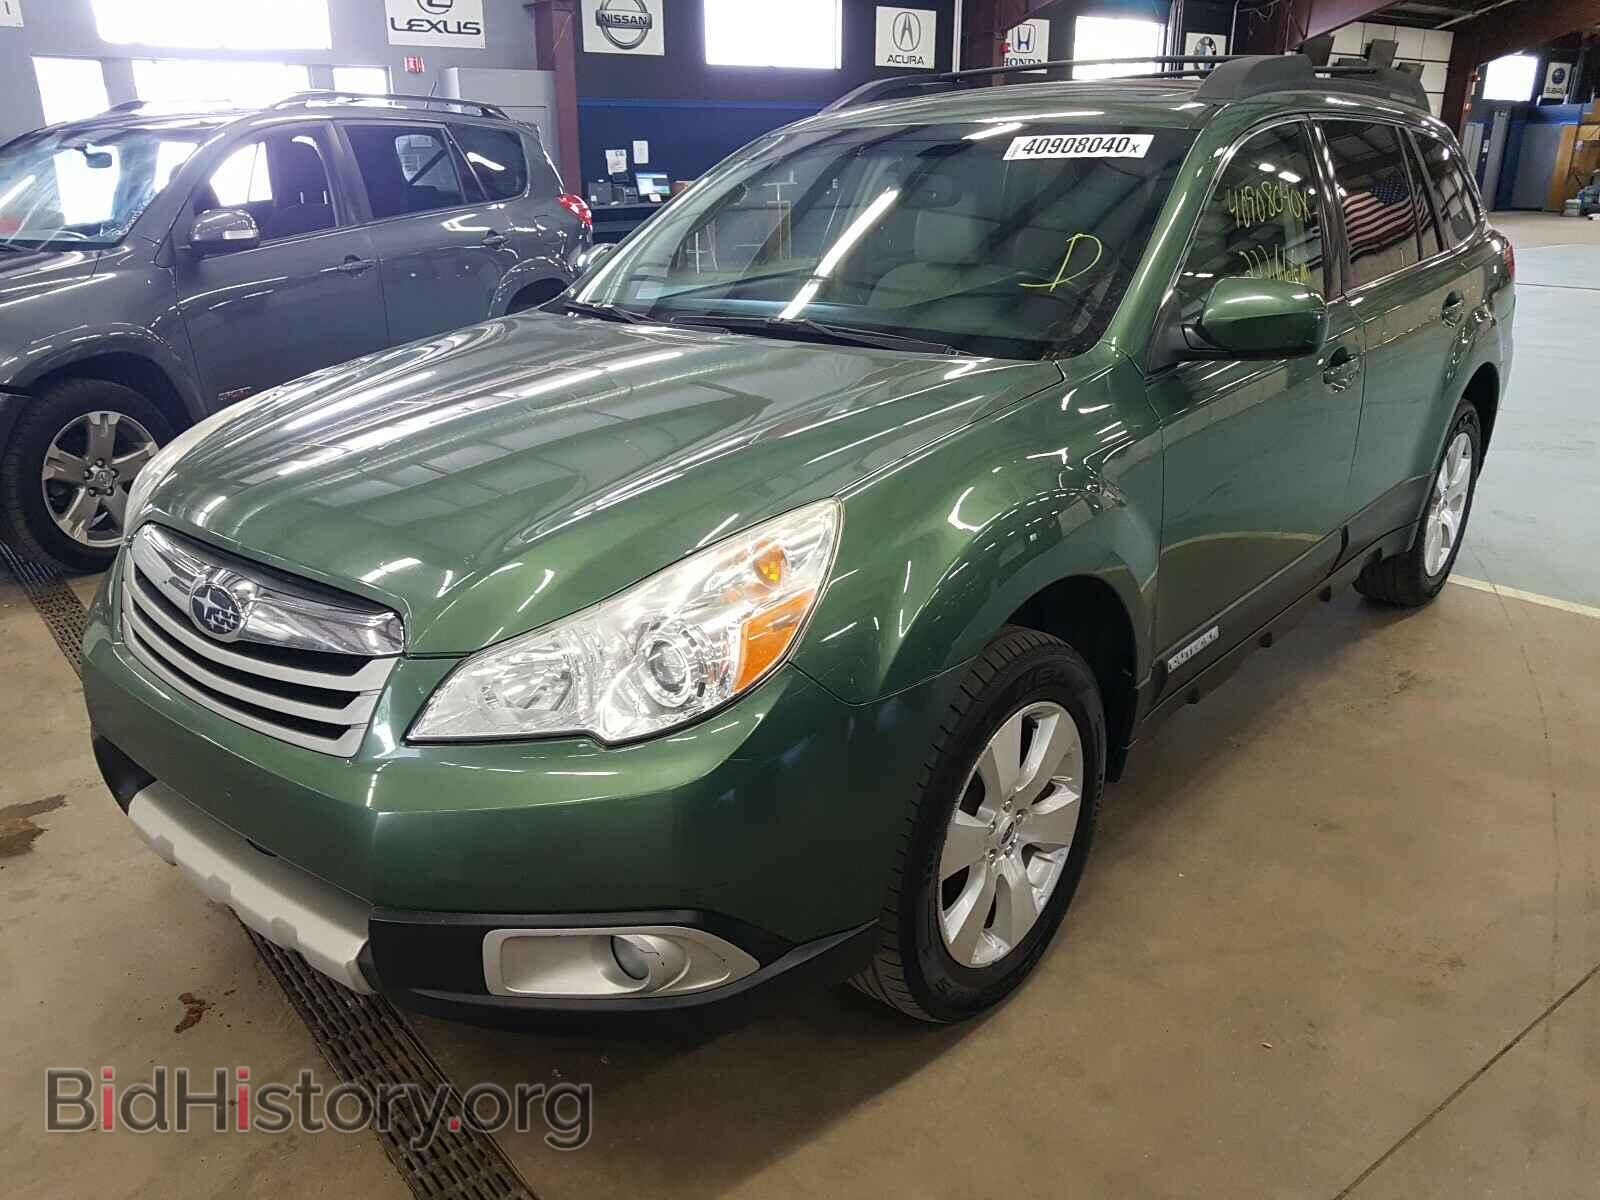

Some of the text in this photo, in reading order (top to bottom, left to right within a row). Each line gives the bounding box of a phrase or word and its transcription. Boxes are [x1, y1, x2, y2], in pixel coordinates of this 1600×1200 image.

[601, 14, 647, 25] NISSAN
[390, 17, 481, 35] LEXUS
[887, 54, 925, 65] ACURA
